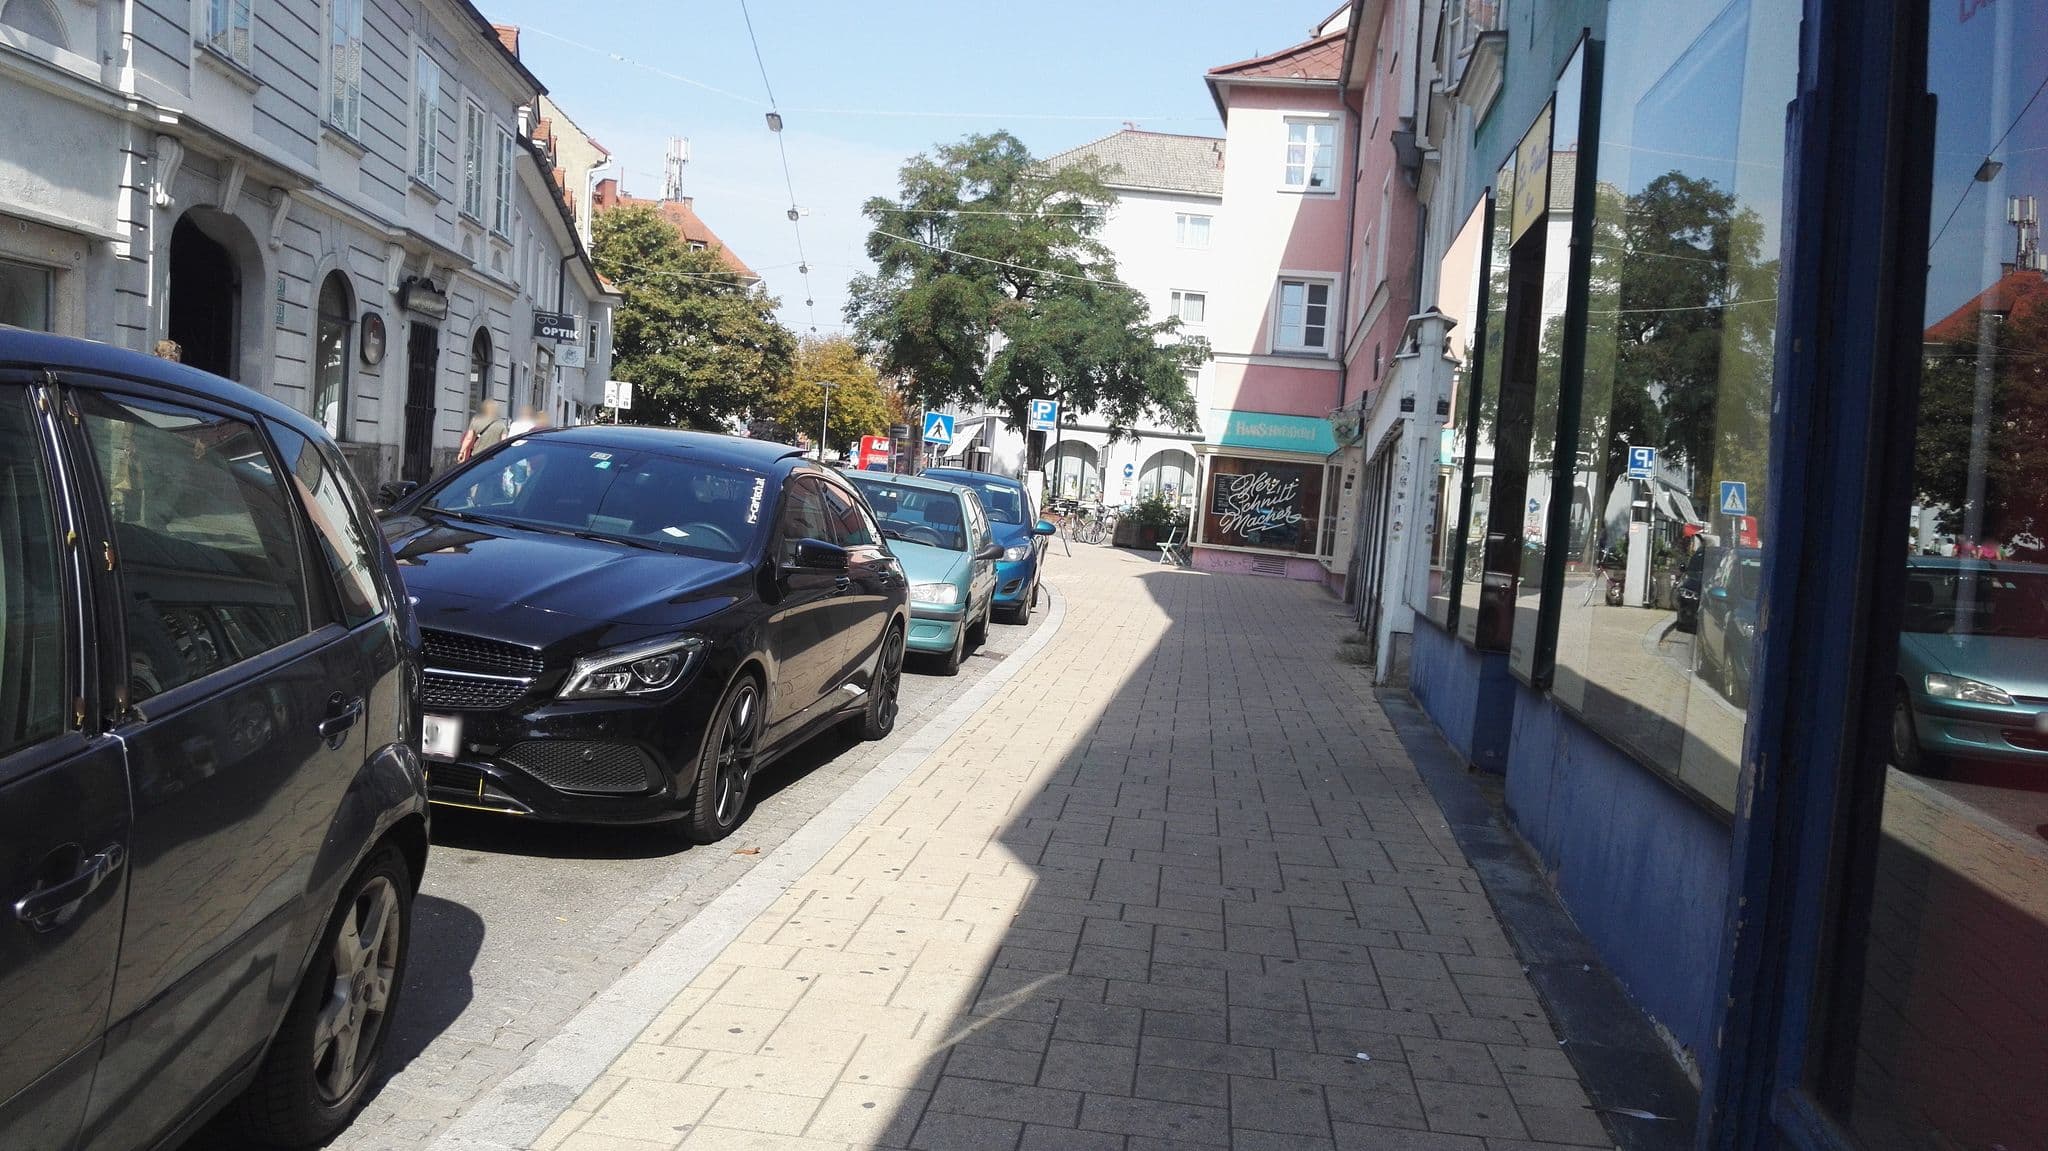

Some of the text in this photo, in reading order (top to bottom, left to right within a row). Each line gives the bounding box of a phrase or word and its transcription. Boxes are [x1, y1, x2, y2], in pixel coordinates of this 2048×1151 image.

[542, 326, 580, 339] OPTIK
[1038, 402, 1051, 420] P
[1220, 505, 1302, 537] Macher
